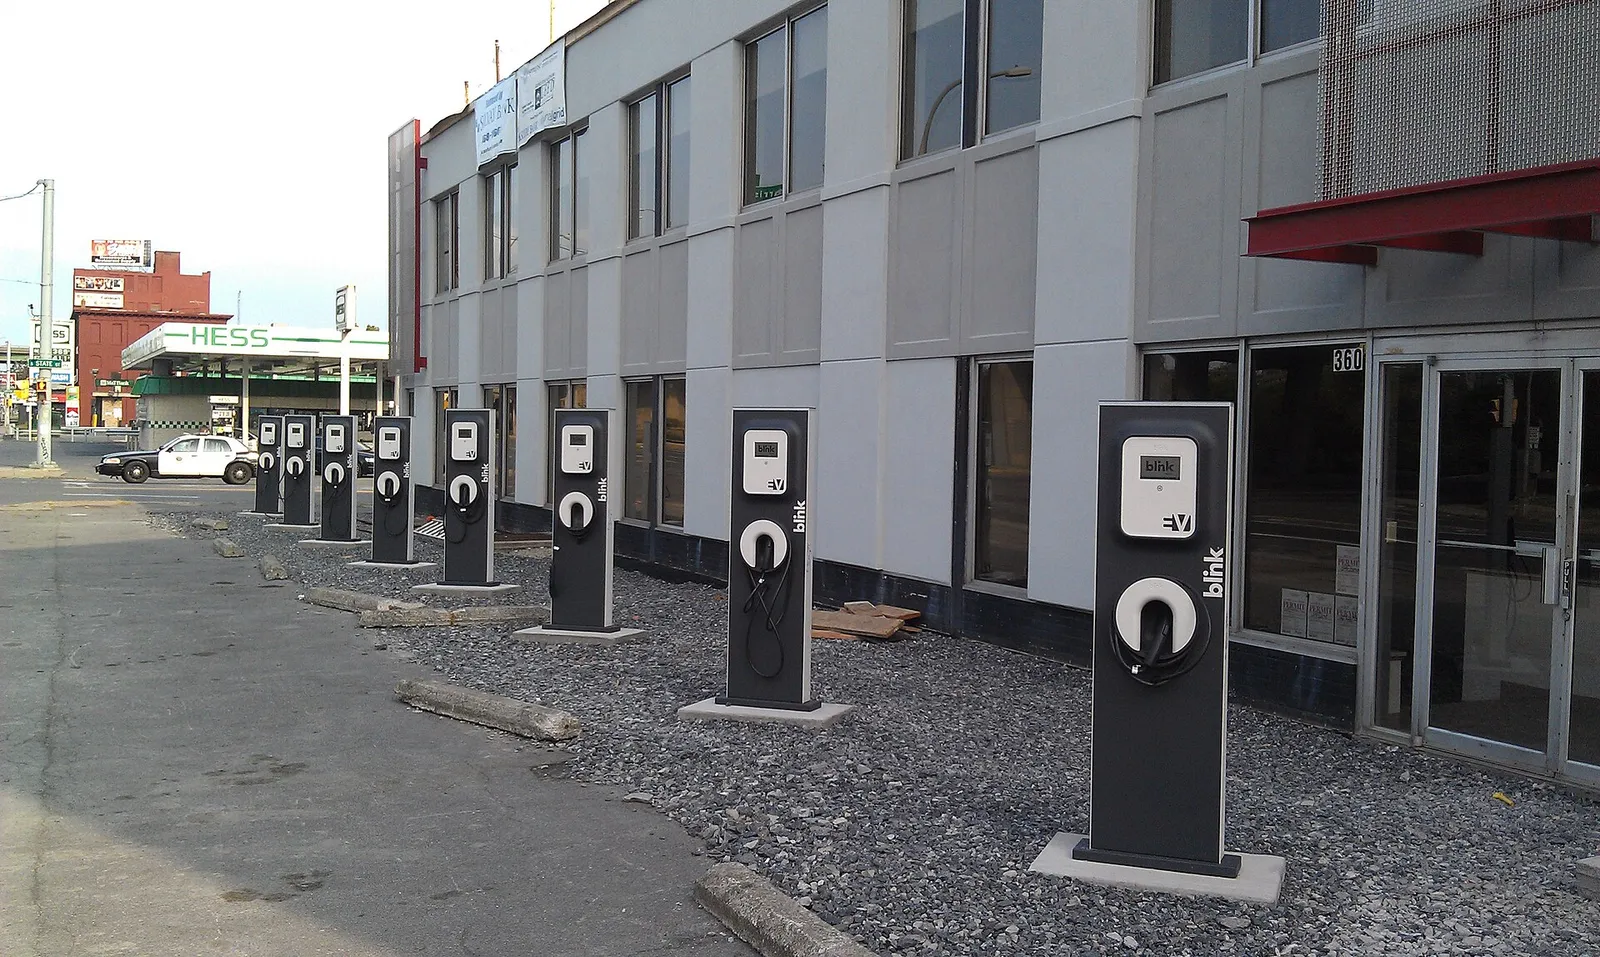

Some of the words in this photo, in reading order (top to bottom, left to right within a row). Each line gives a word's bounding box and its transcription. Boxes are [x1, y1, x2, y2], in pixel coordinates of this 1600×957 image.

[192, 326, 269, 348] HESS
[1334, 349, 1361, 371] 360
[758, 445, 775, 453] blink
[481, 463, 489, 483] blink
[1146, 461, 1174, 472] blink
[597, 477, 607, 502] blink
[793, 500, 806, 533] blink
[1202, 547, 1224, 598] blink
[1283, 600, 1306, 611] PERMIT
[1310, 604, 1332, 615] PERMIT
